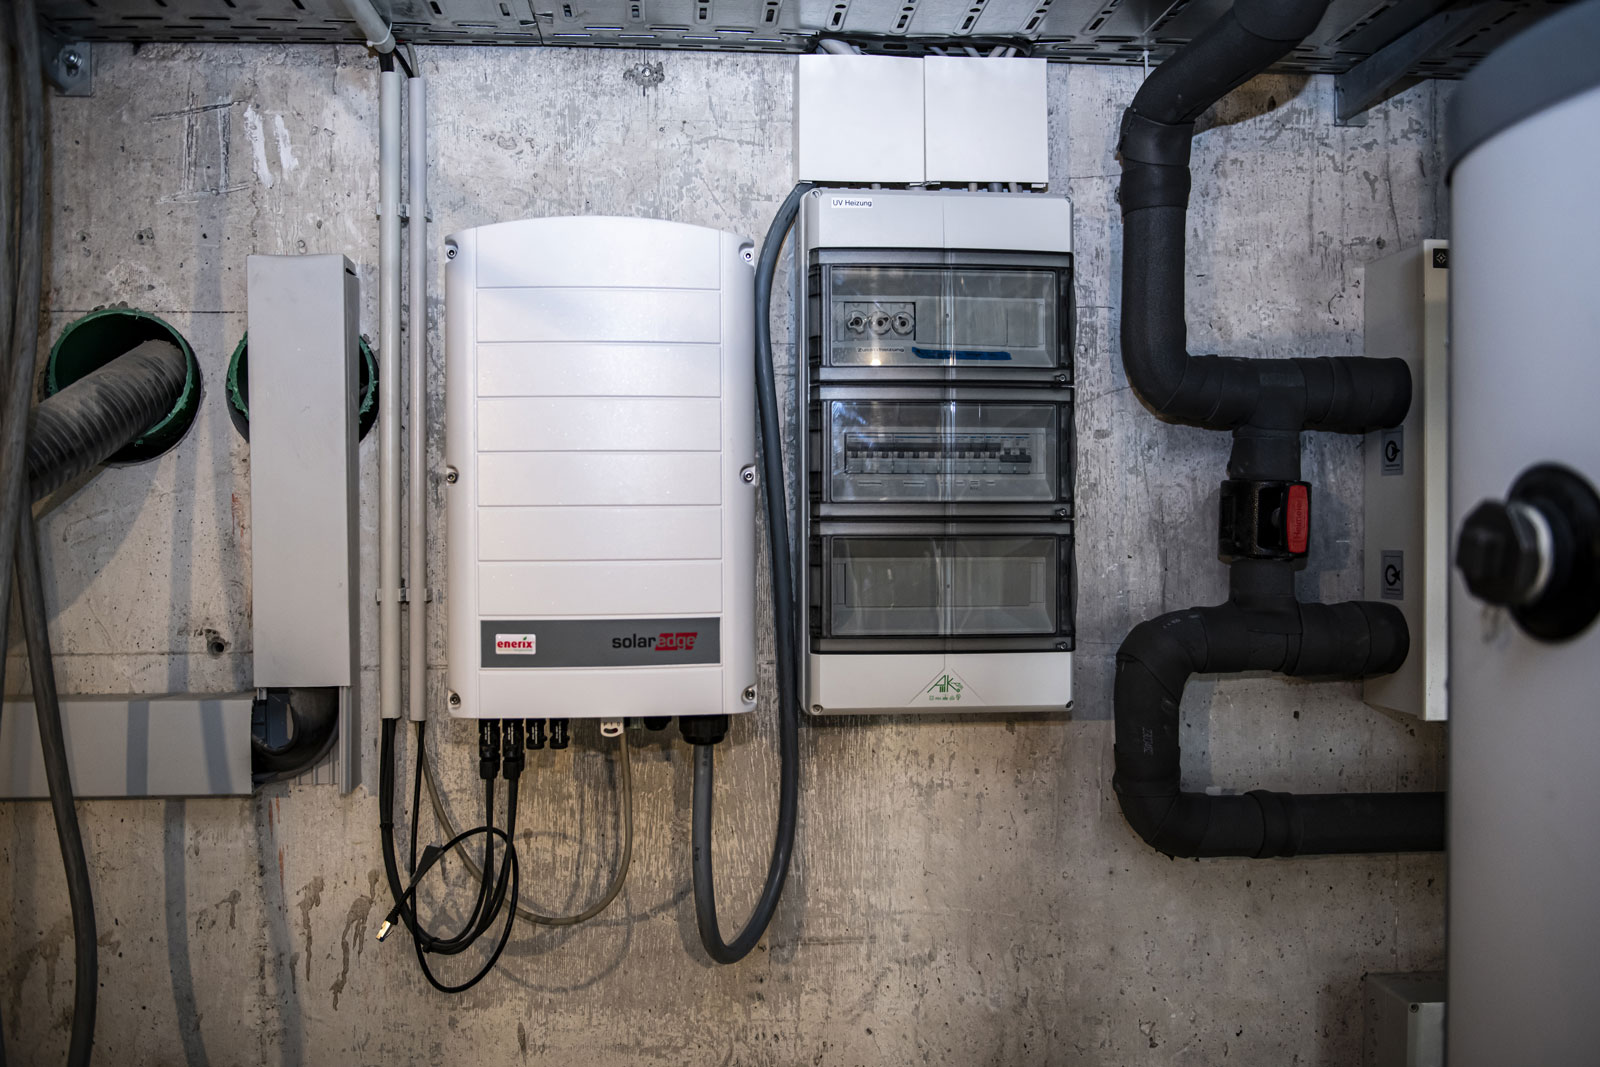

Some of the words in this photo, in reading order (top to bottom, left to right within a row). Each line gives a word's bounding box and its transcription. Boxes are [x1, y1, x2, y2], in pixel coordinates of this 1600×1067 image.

[845, 199, 873, 207] Heizung
[496, 640, 533, 649] enerix
[611, 632, 698, 652] solaredge
